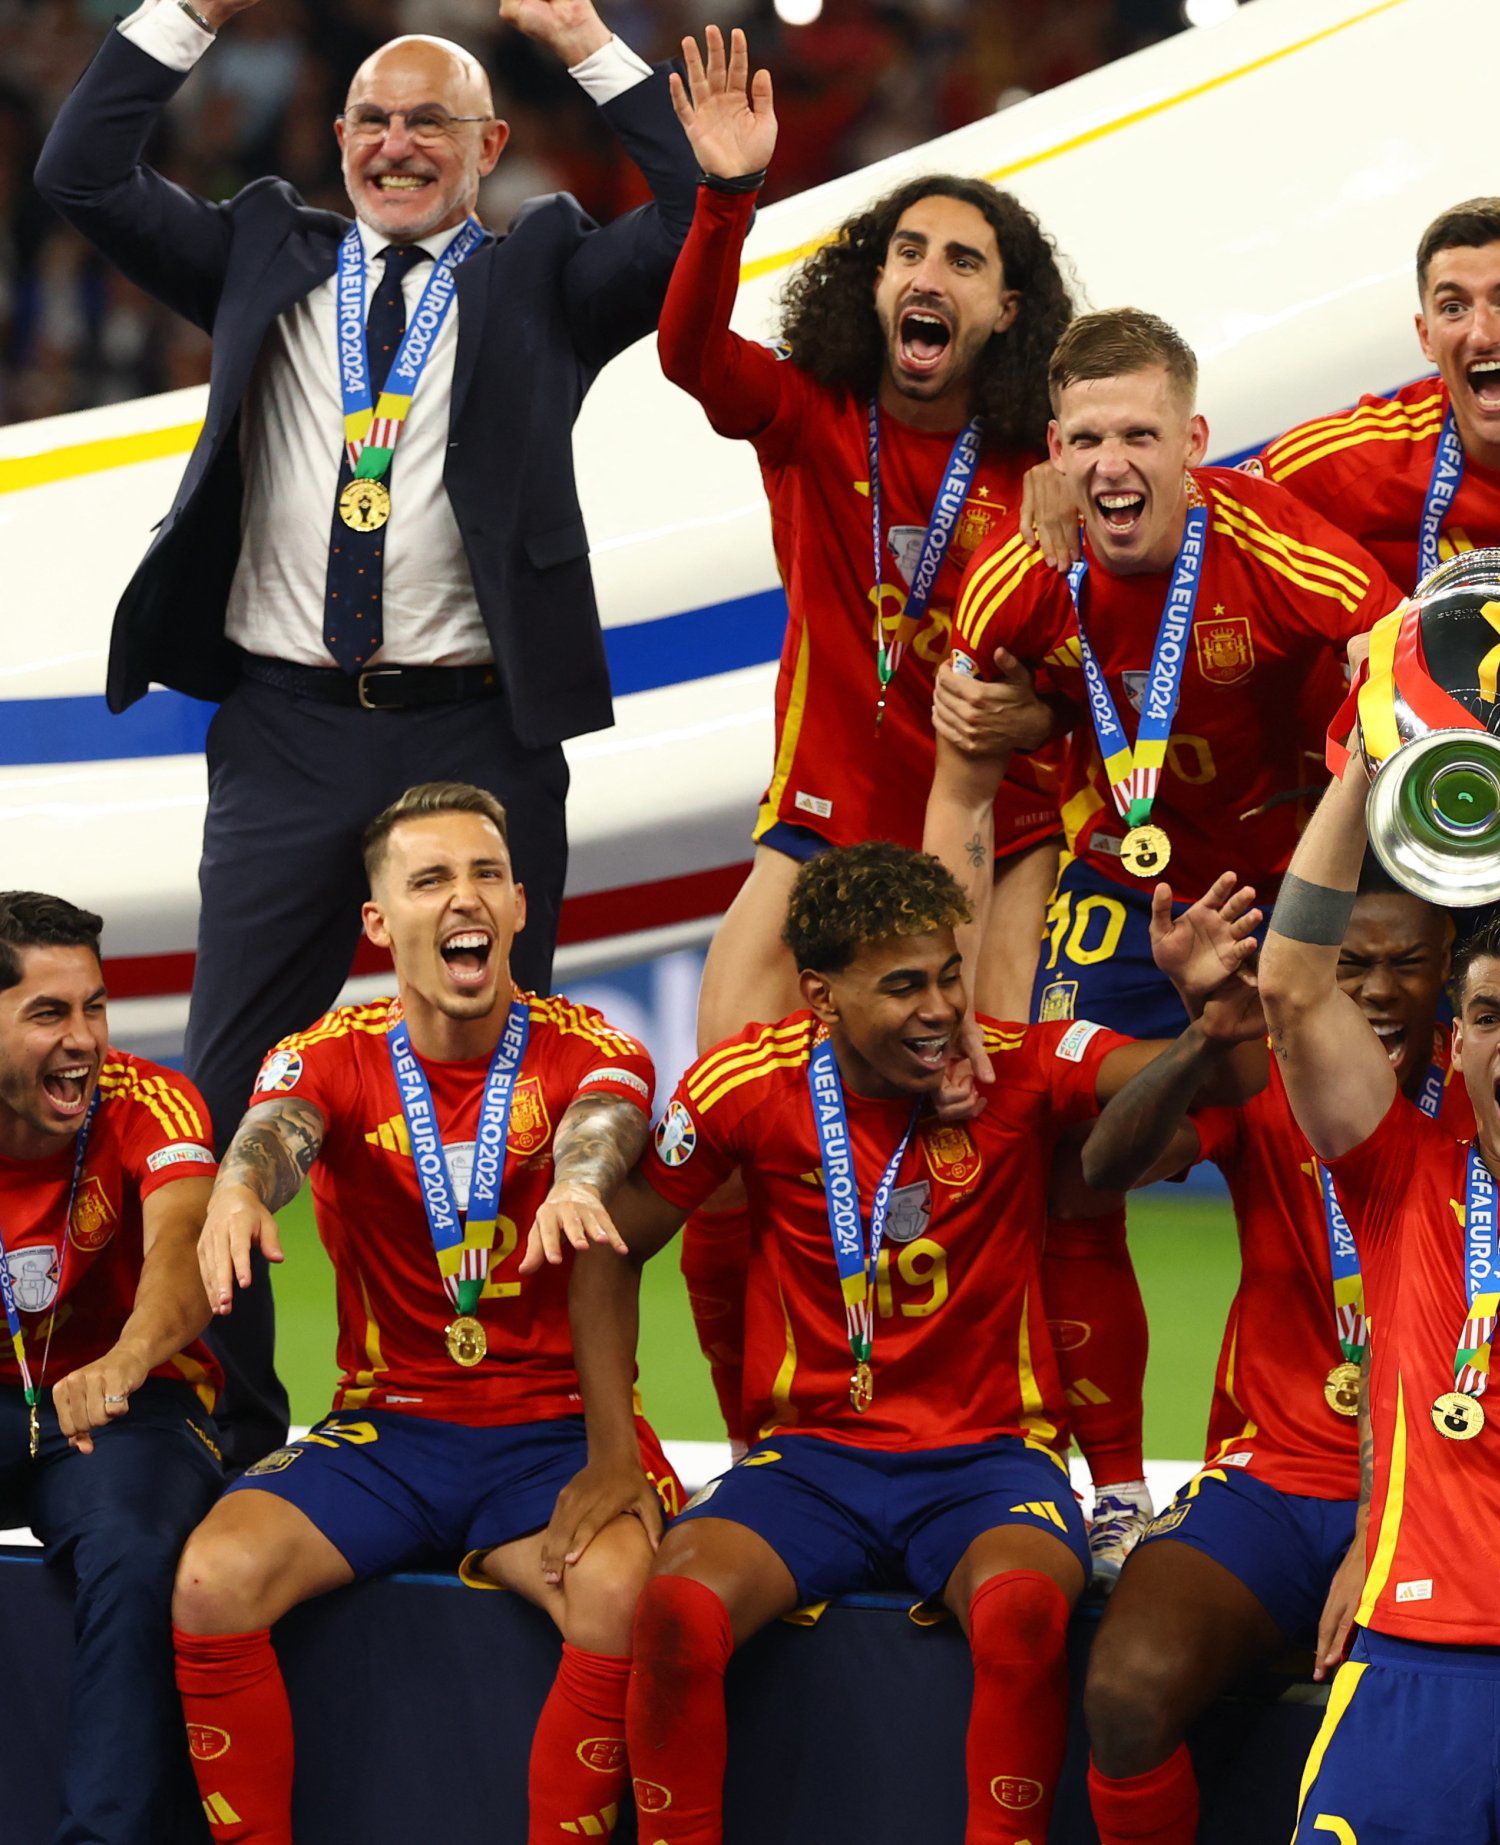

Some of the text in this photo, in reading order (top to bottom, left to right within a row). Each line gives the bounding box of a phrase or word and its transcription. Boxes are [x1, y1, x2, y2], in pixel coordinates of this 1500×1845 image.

[1147, 520, 1203, 720] UEFAEURO2024
[1045, 890, 1128, 970] 10
[392, 1036, 454, 1229] UEFAEURO2024
[473, 1013, 524, 1201] UEFAEURO2024
[814, 1054, 860, 1256] UEFAEURO2024
[865, 1238, 949, 1318] 19
